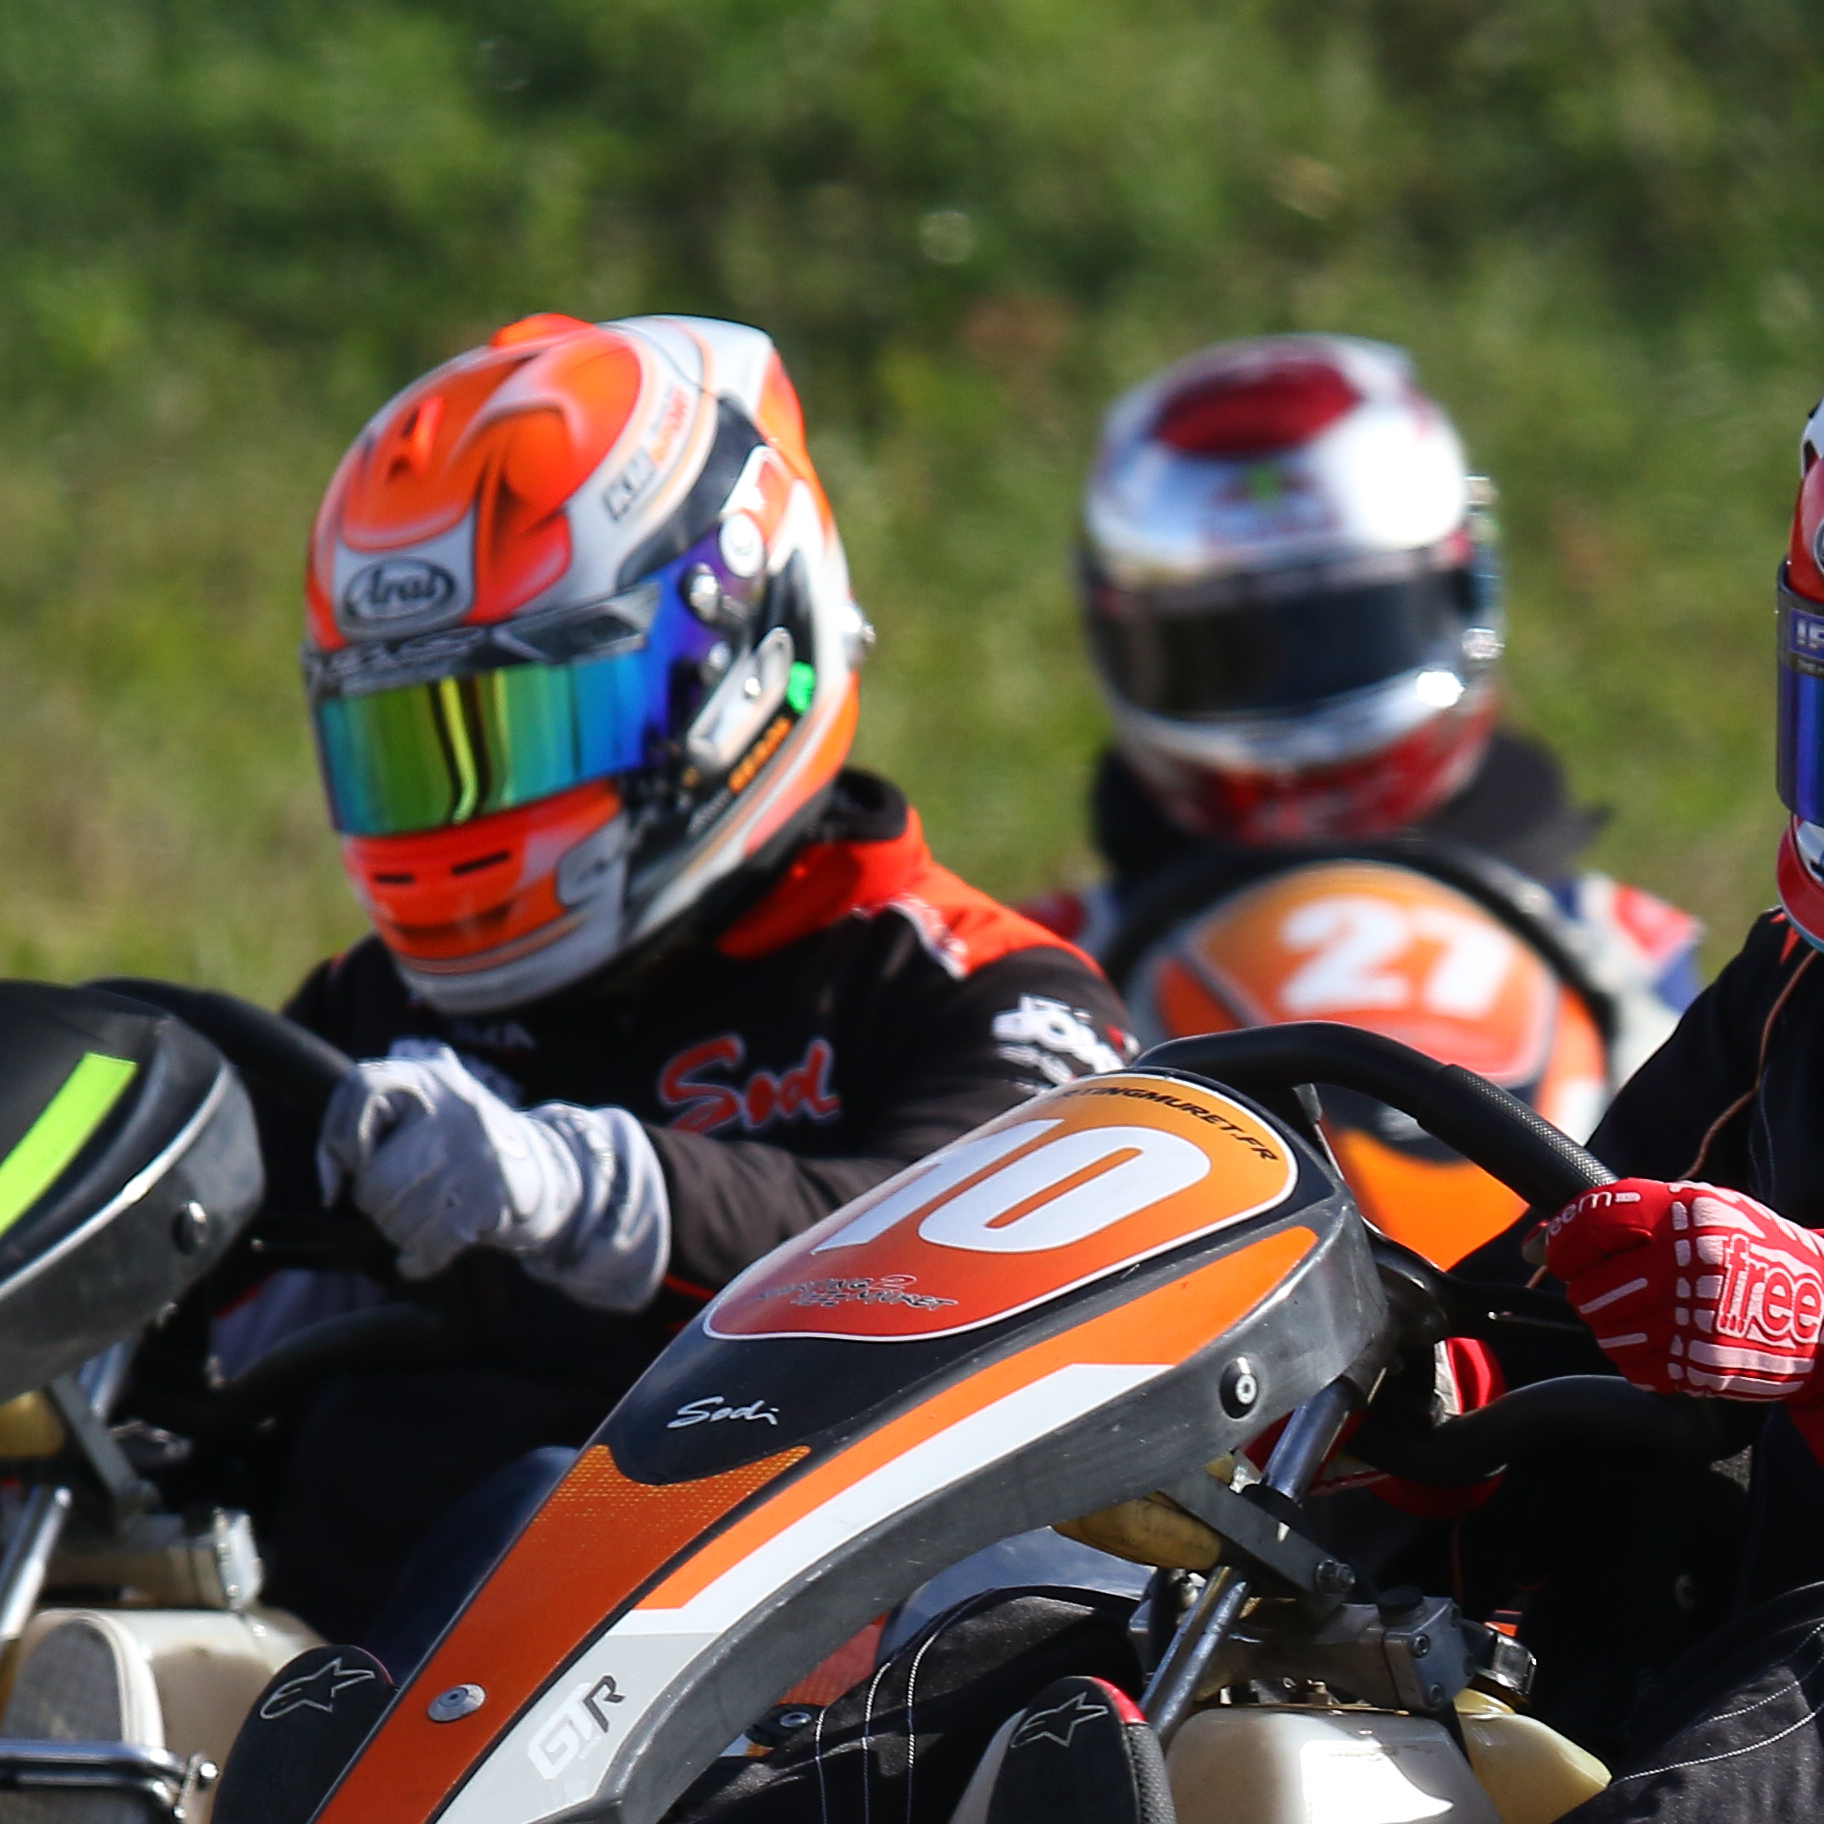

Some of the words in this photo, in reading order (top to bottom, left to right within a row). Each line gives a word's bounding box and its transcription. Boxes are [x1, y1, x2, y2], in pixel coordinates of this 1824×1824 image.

[810, 1118, 1213, 1256] 10
[666, 1395, 780, 1428] Sodi
[526, 1673, 626, 1781] GTR
